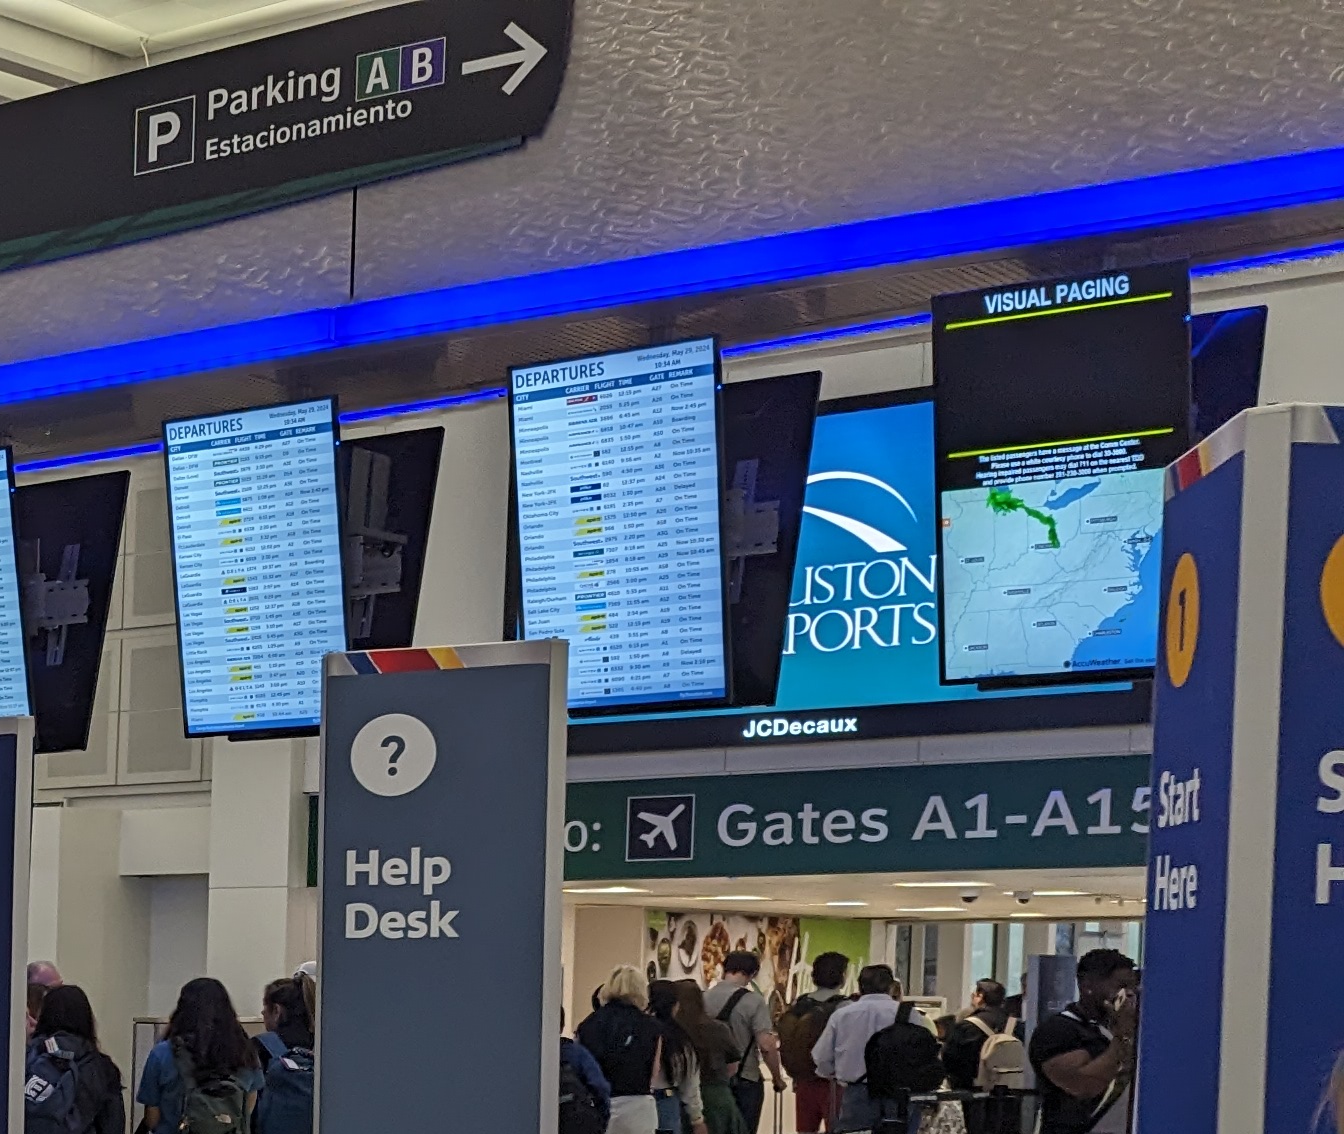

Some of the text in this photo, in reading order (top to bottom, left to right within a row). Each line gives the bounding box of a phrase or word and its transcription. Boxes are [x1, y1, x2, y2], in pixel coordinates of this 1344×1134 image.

[207, 46, 434, 121] Parking A B
[147, 111, 181, 164] P
[205, 98, 413, 161] Estacionamiento
[985, 275, 1130, 314] VISUAL PAGING
[515, 361, 605, 389] DEPARTURES
[637, 353, 670, 361] Wednesday,
[565, 385, 590, 394] CARRIER
[594, 381, 615, 389] FLIGHT
[619, 378, 633, 386] TIME
[649, 373, 665, 381] GATE
[669, 369, 693, 378] REMARK
[169, 418, 243, 441] DEPARTURES
[671, 415, 696, 423] Boarding
[1006, 451, 1037, 460] passengers
[1057, 445, 1082, 453] message
[1023, 465, 1054, 474] passengers
[789, 554, 937, 607] USTON
[783, 602, 936, 655] PORTS
[1178, 588, 1187, 652] 1
[1072, 658, 1121, 667] AccuWeather
[743, 716, 858, 739] JCDecaux
[1157, 768, 1201, 829] Start
[565, 814, 602, 853] o:
[717, 802, 889, 848] Gates
[345, 847, 452, 896] Help
[1153, 854, 1198, 912] Here
[344, 900, 460, 939] Desk
